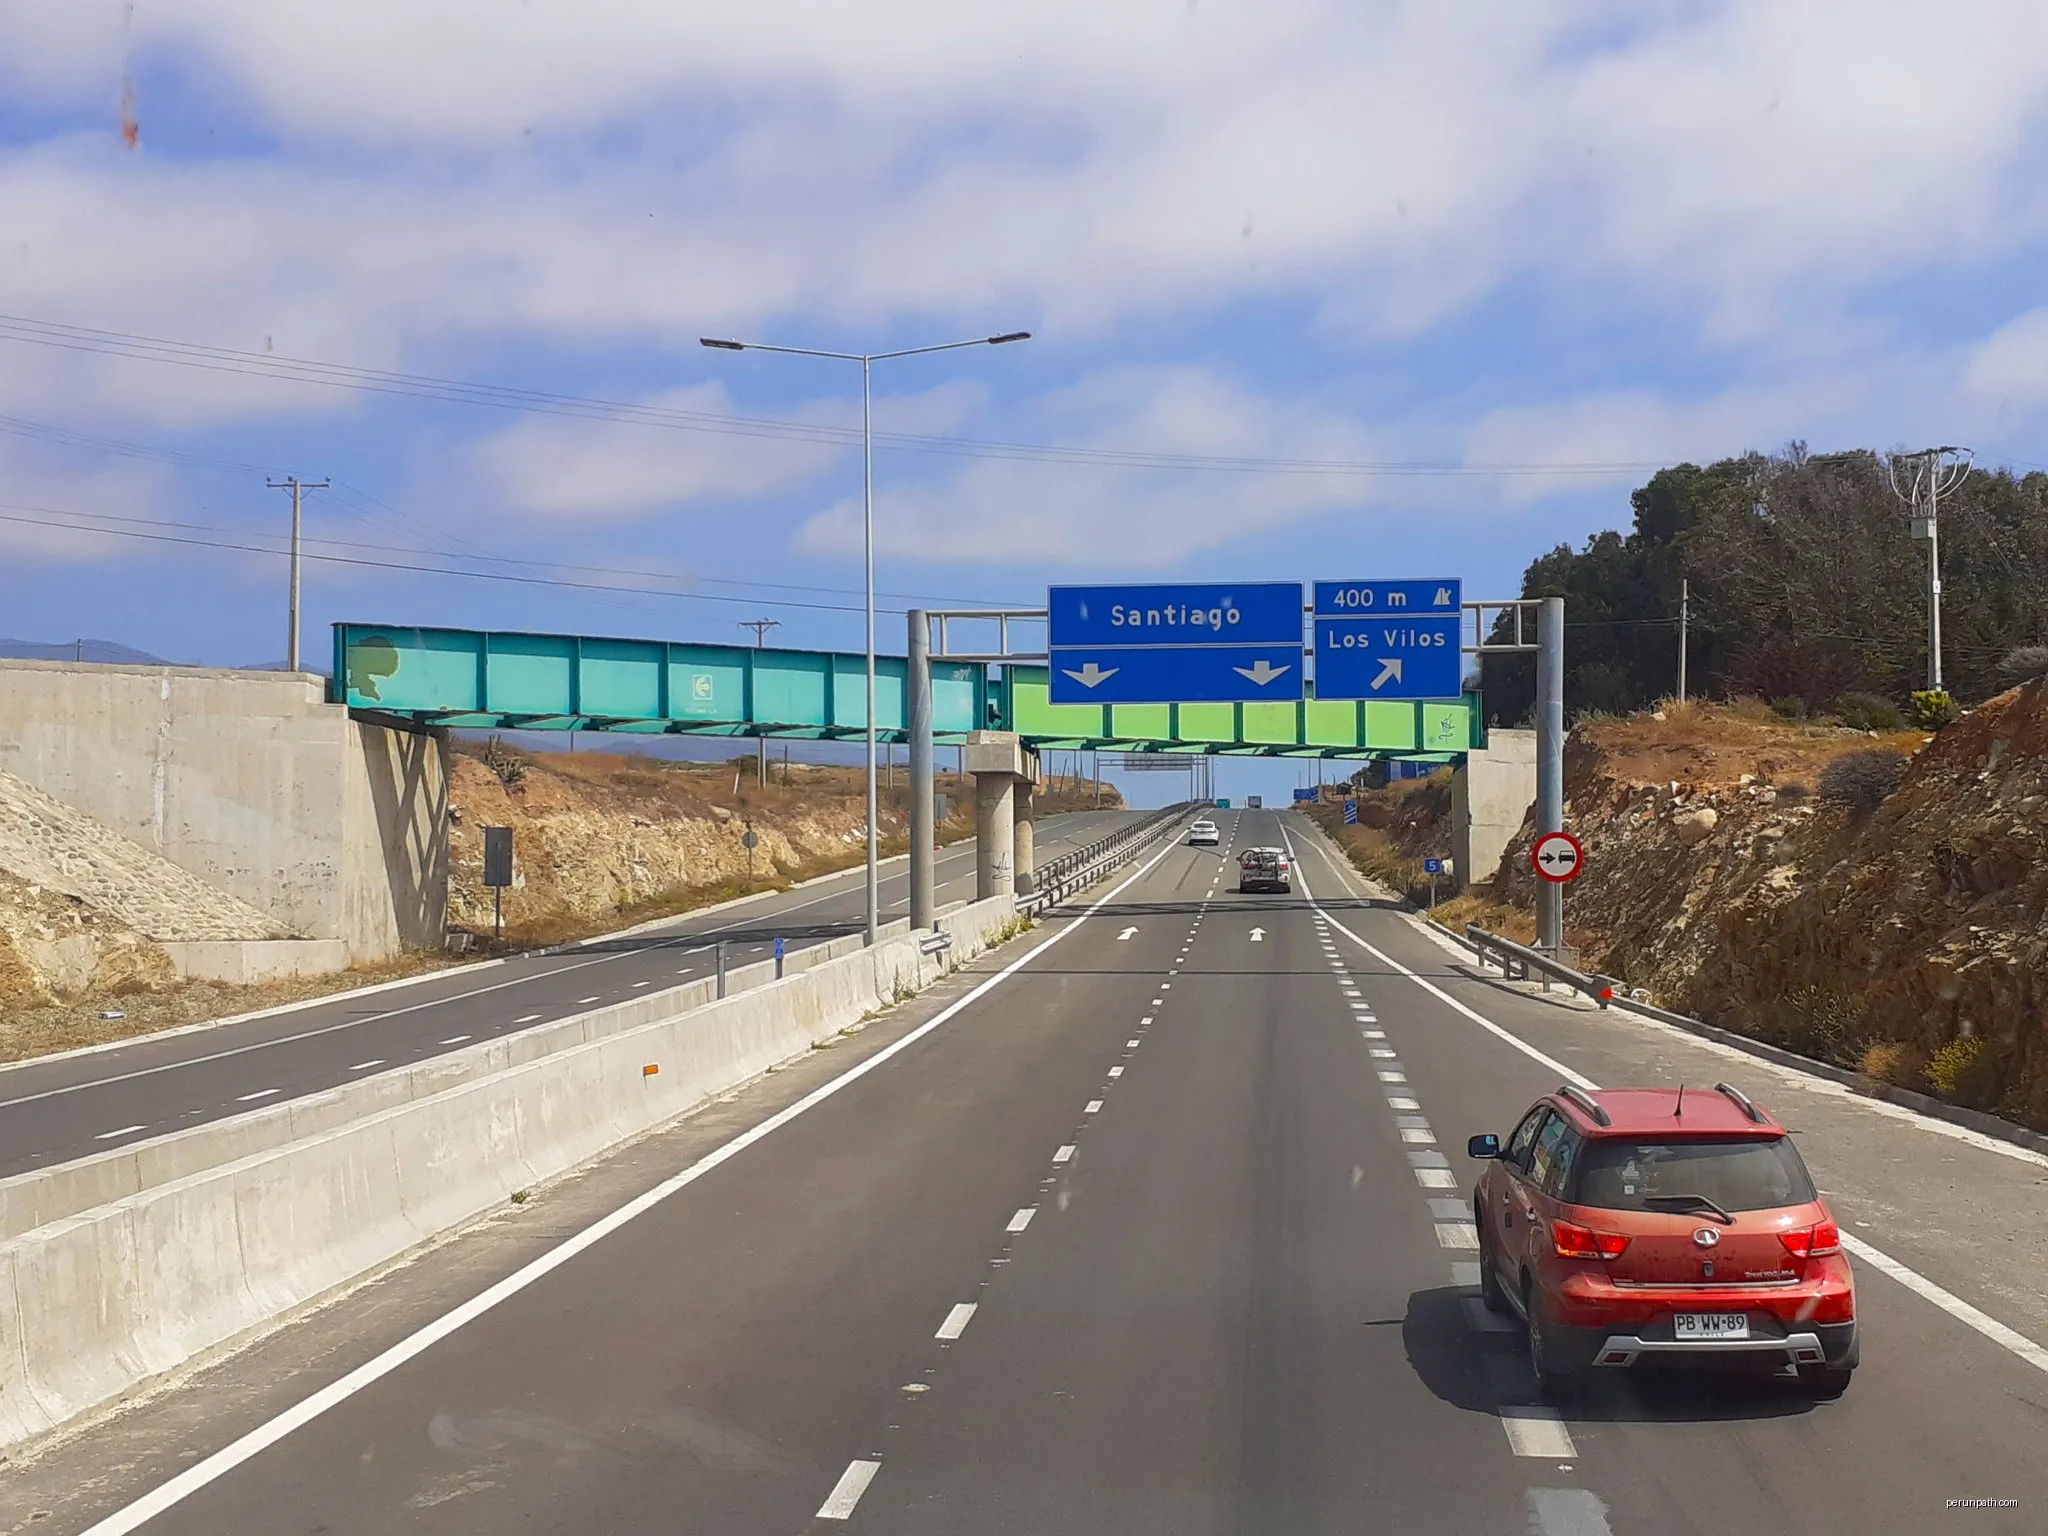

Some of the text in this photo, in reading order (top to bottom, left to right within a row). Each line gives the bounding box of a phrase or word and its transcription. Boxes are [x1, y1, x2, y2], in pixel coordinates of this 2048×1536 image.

[1334, 588, 1407, 608] 400 m
[1111, 604, 1241, 632] Santiago
[1329, 629, 1446, 649] Los Vilos
[1428, 860, 1437, 871] 5
